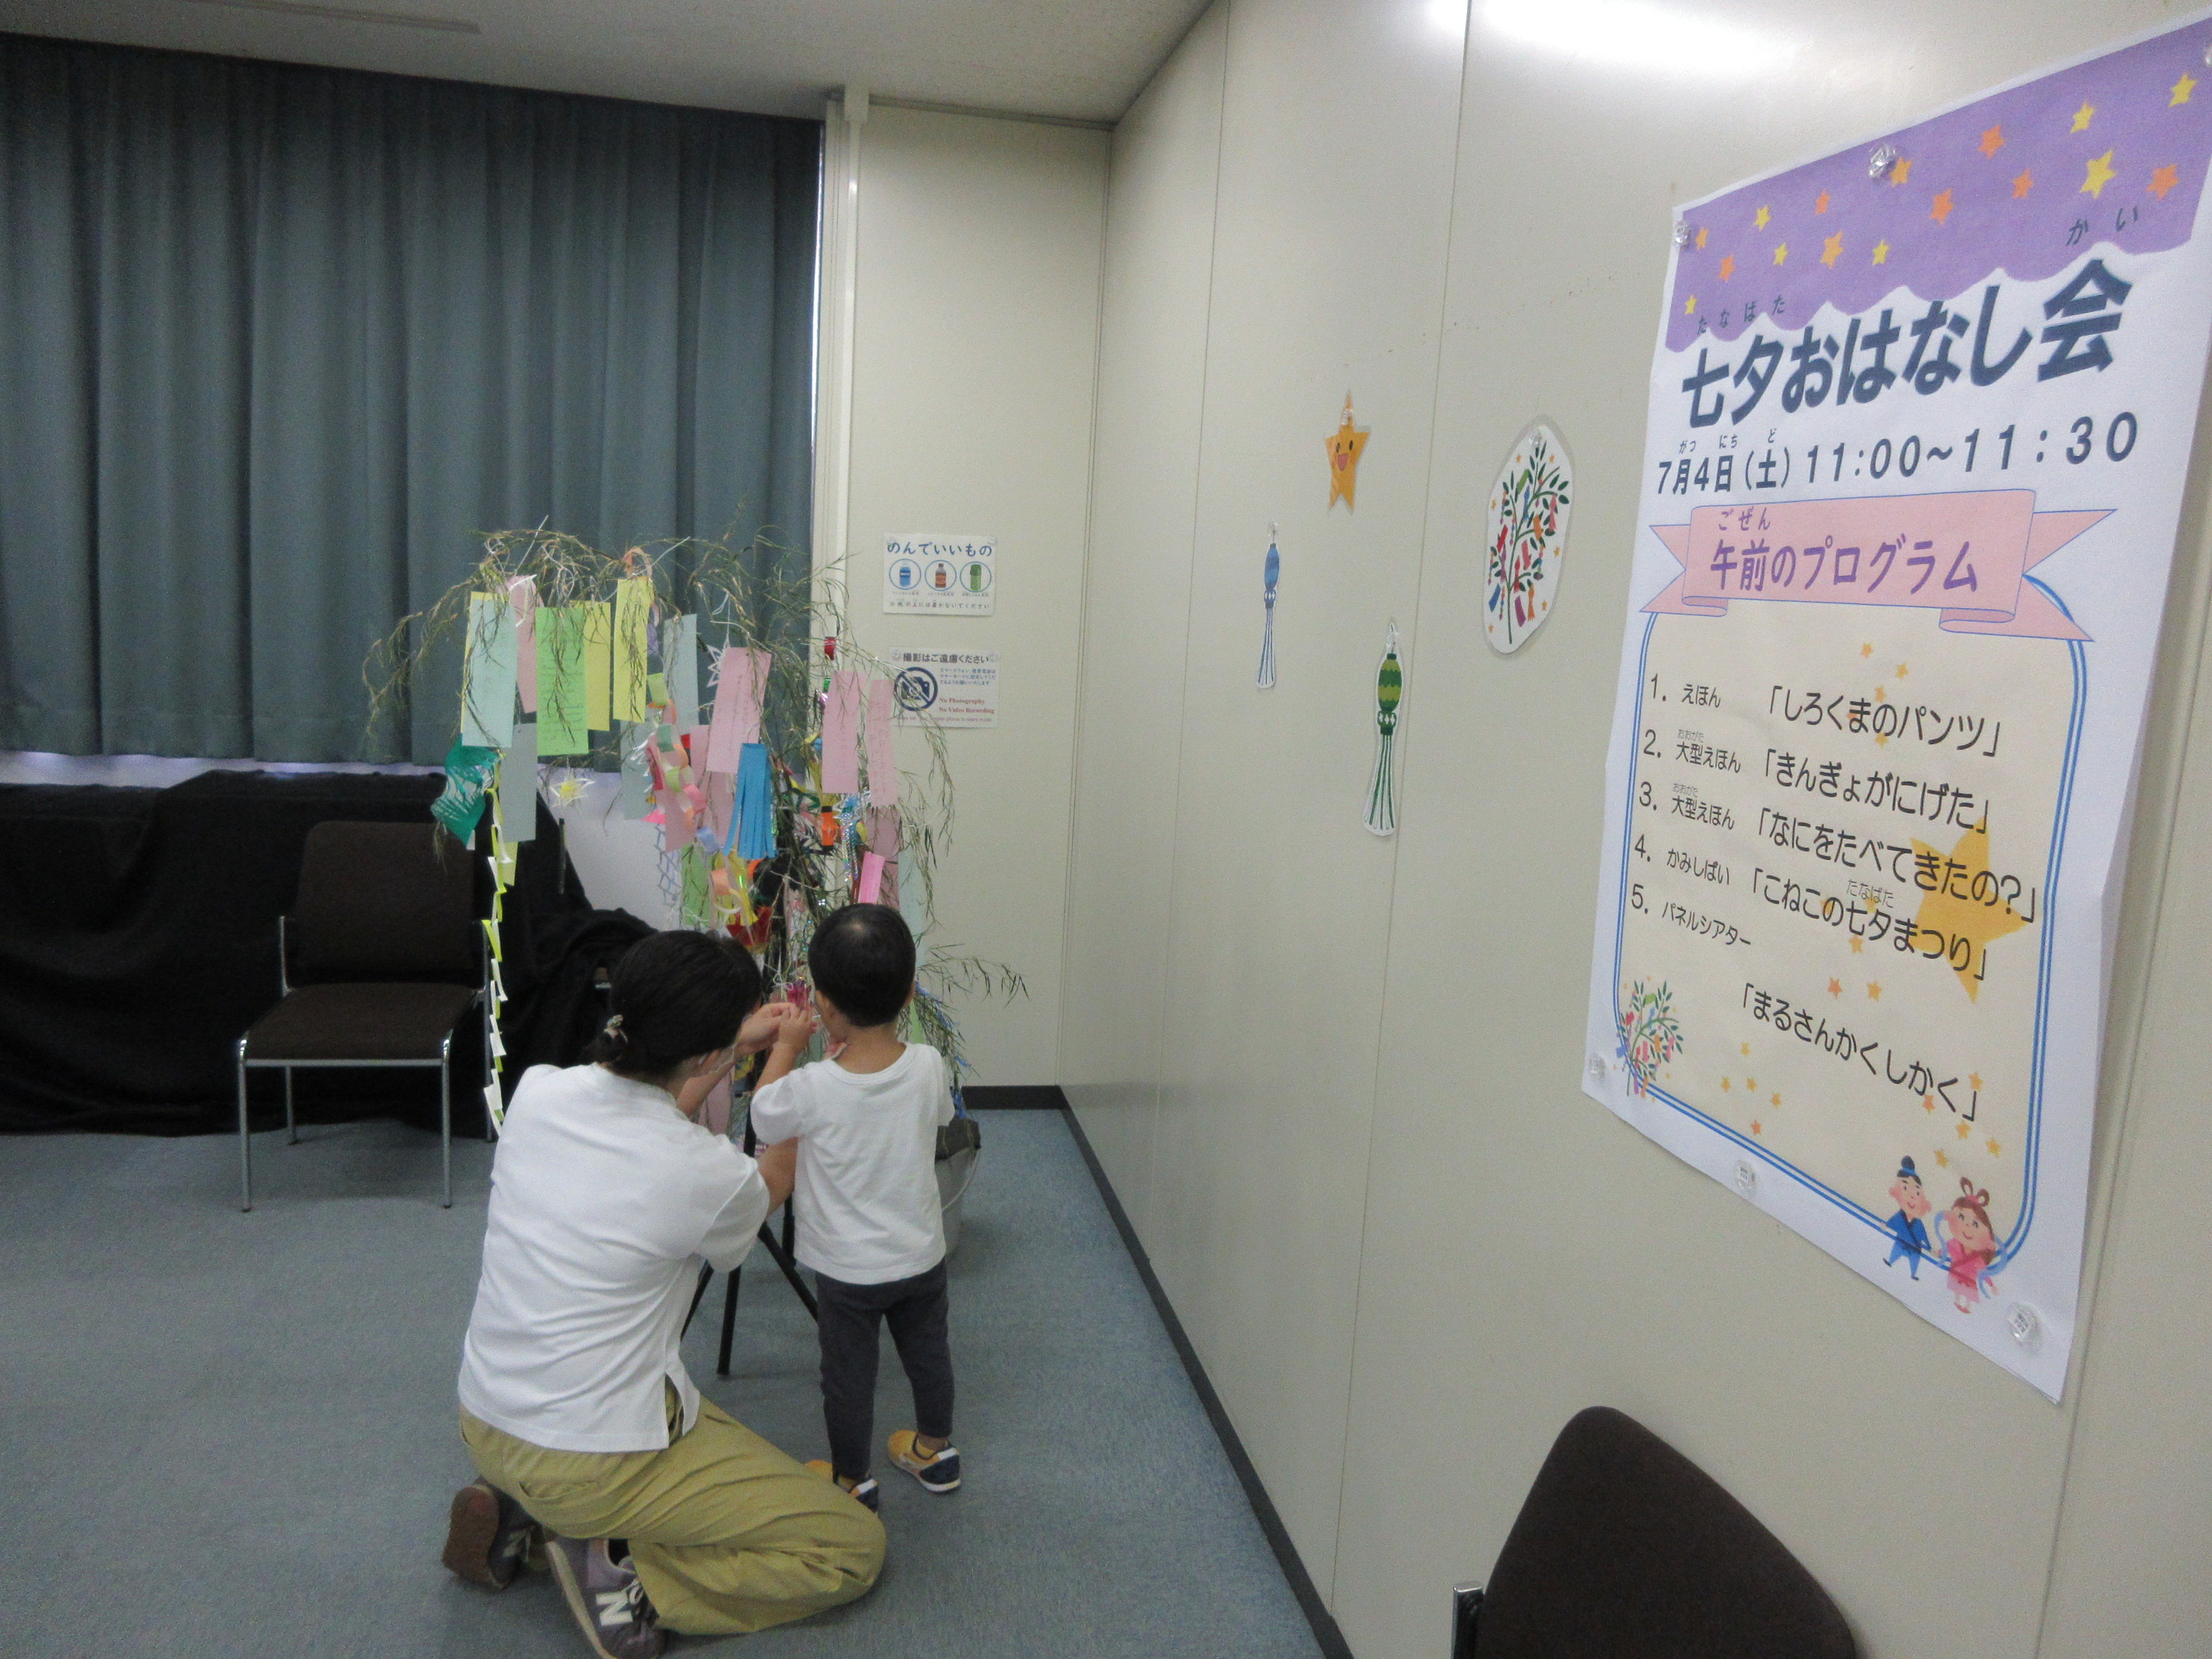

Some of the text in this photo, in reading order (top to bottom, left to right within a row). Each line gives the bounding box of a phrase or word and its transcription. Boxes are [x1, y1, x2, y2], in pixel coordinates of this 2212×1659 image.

[1681, 258, 2133, 428] 七夕おはなし会
[1679, 427, 1777, 454] がつ にち ど
[886, 541, 993, 557] のんでいいもの
[1718, 506, 1771, 531] ごぜん
[1711, 535, 1977, 594] 午前のプログラム
[903, 653, 989, 664] 撮影はご遠慮ください
[1650, 674, 2001, 757] 1. えほん 「しろくまのパンツ」
[1643, 729, 1991, 834] 2. 大型えほん 「きんぎょがにげた」
[1639, 781, 2037, 923] 3. 大型えほん 「なにをたべてきたの?」
[1632, 885, 1752, 947] 5. パネルシアター
[1634, 834, 1986, 980] 4. かみしばい 「こねこの七夕まつり」
[1743, 983, 1978, 1122] 「まるさんかくしかく」
